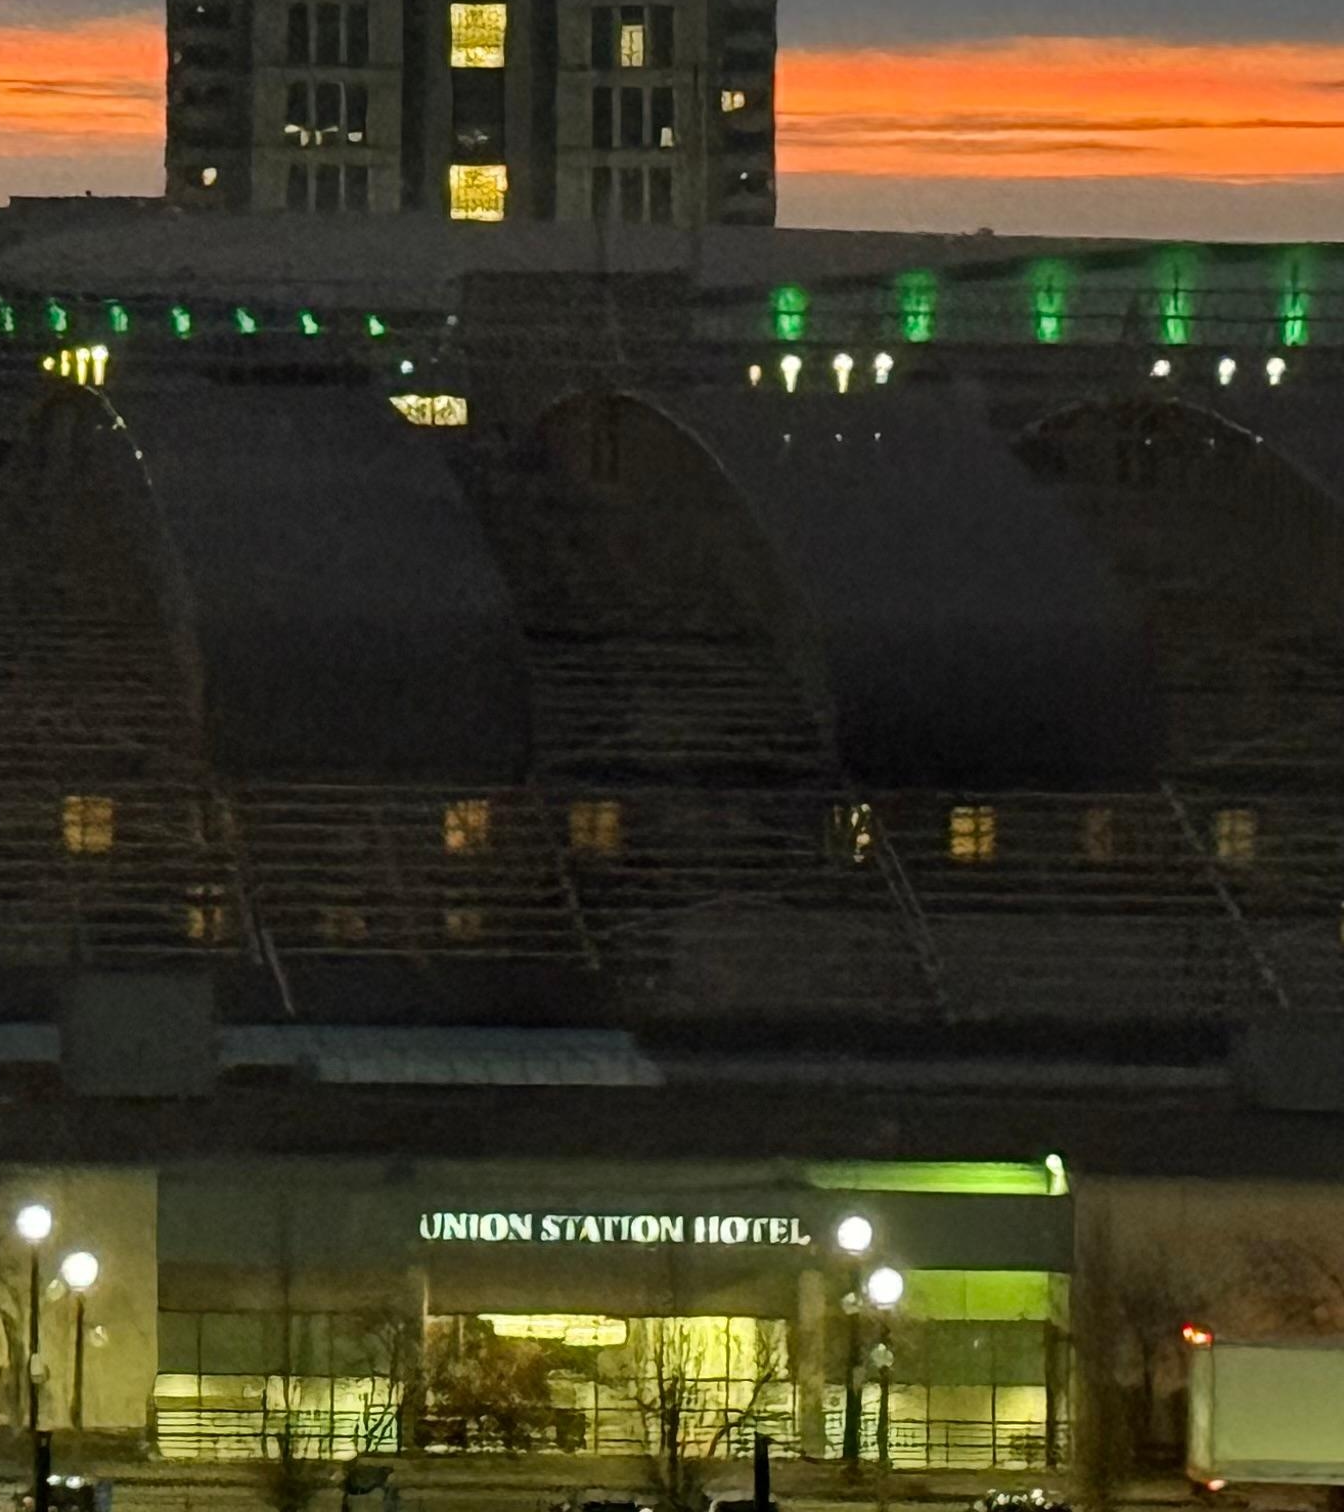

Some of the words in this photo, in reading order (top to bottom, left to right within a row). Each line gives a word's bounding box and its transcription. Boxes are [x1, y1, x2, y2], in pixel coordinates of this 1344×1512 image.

[420, 1213, 531, 1240] UNION
[541, 1215, 684, 1242] STATION
[694, 1216, 810, 1245] HOTEL
